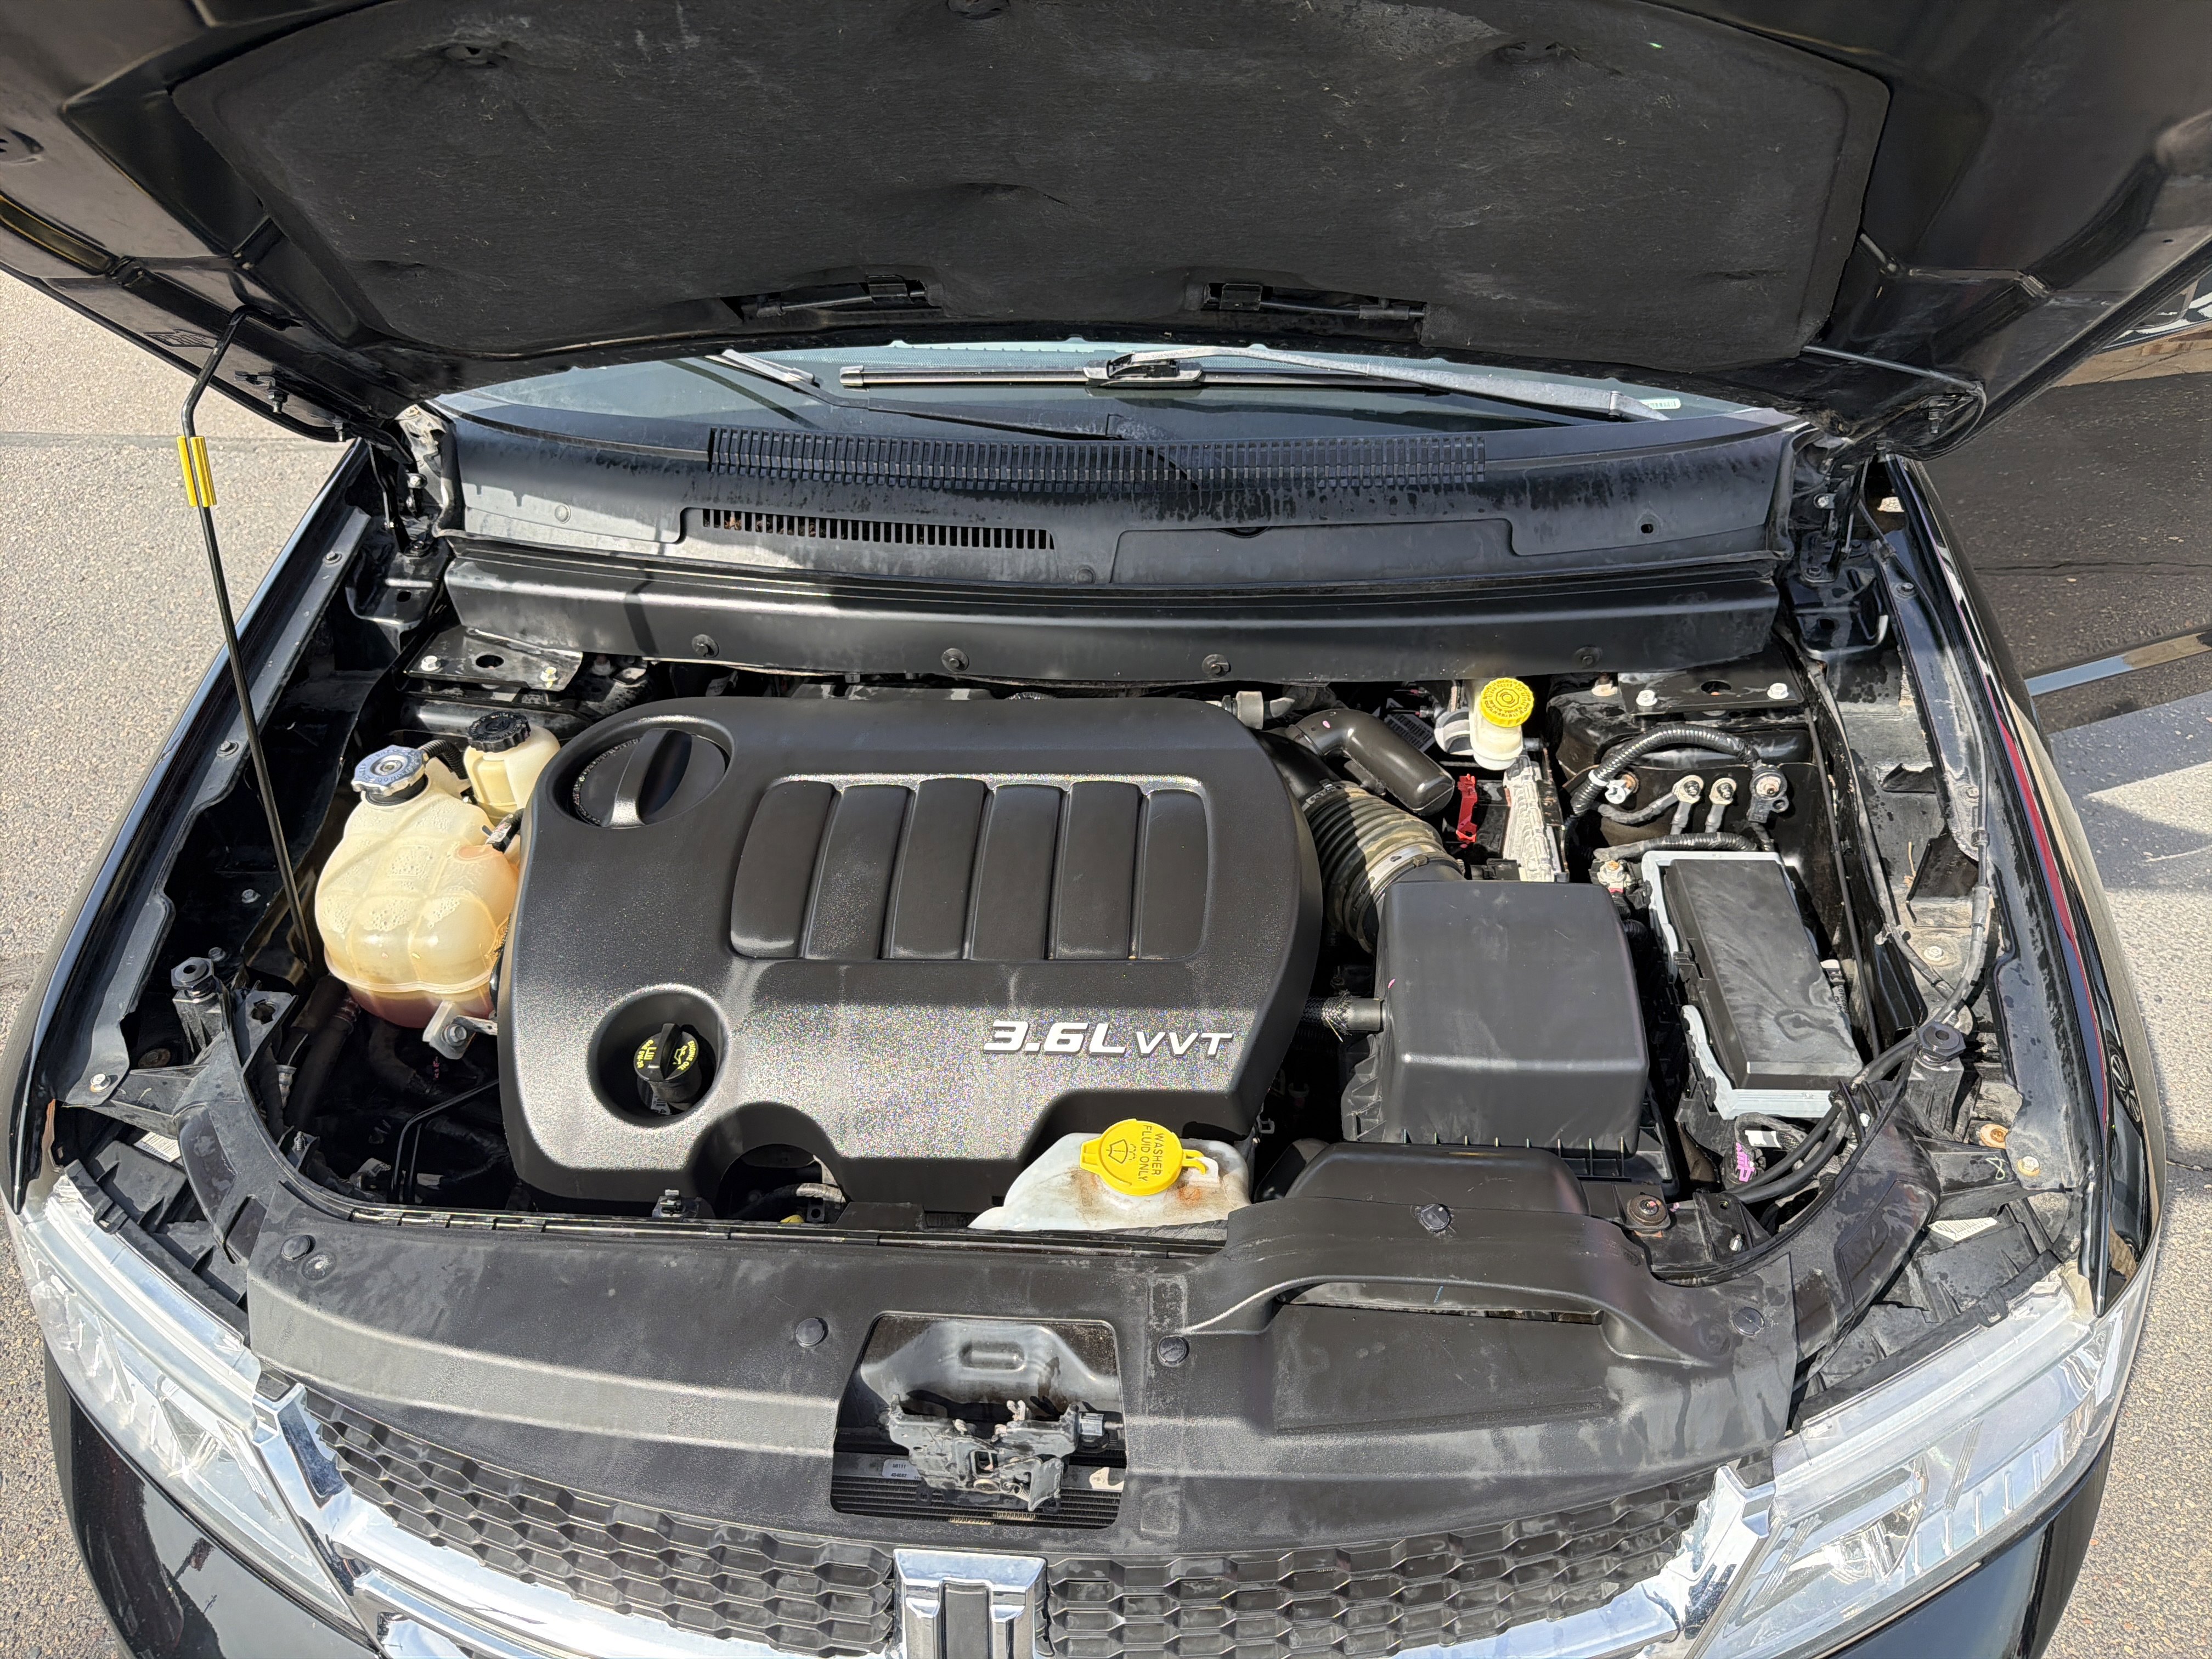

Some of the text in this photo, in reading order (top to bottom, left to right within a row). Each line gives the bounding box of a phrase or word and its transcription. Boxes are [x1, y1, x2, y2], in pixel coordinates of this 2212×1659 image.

[676, 1040, 696, 1071] ENGINE OIL
[984, 1020, 1234, 1059] 3.6L VVT
[1138, 1125, 1153, 1182] FLUID ONLY
[1152, 1132, 1165, 1176] WASHER
